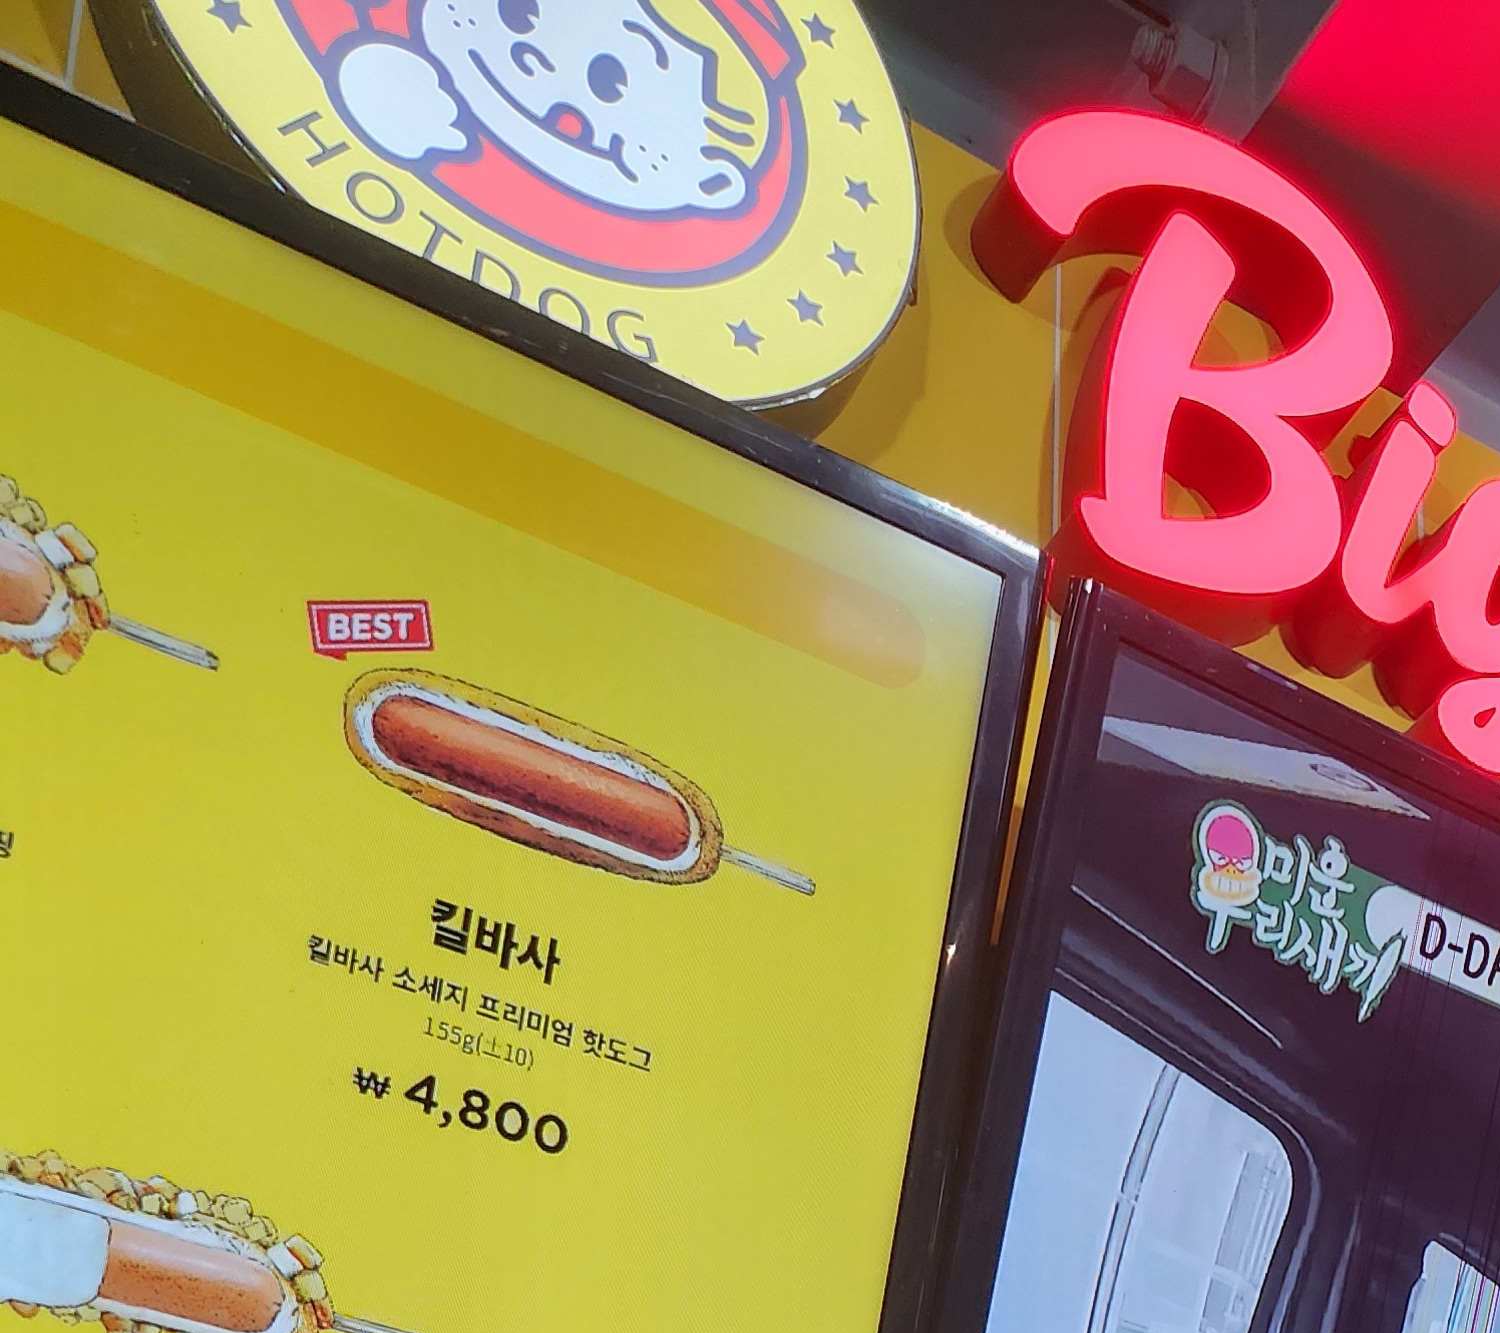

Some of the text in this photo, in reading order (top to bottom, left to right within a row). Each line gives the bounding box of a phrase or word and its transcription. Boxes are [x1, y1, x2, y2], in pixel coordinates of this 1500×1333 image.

[277, 111, 661, 363] HOTDOG
[327, 612, 414, 643] BEST
[431, 899, 561, 984] 킬바사
[309, 934, 652, 1072] 킬바사 소세지 프리미엄 핫도그
[423, 1017, 534, 1071] 155g(±10)
